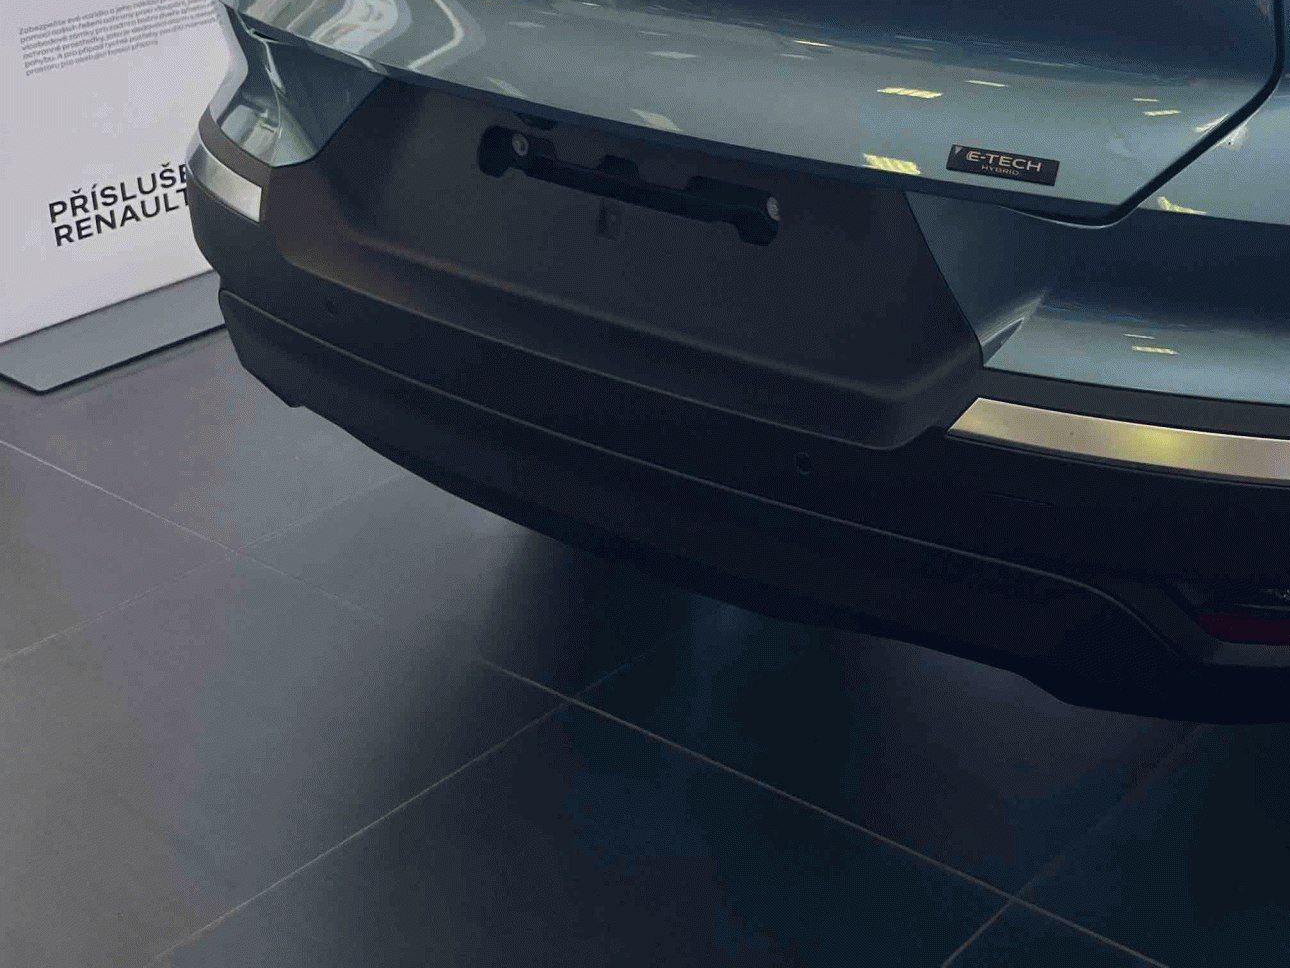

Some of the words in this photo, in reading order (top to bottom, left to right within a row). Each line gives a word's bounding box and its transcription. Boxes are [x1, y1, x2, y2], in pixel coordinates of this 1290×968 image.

[966, 150, 1042, 172] E-TECH
[981, 164, 1020, 176] HYBRID
[54, 187, 189, 247] RENAULT
